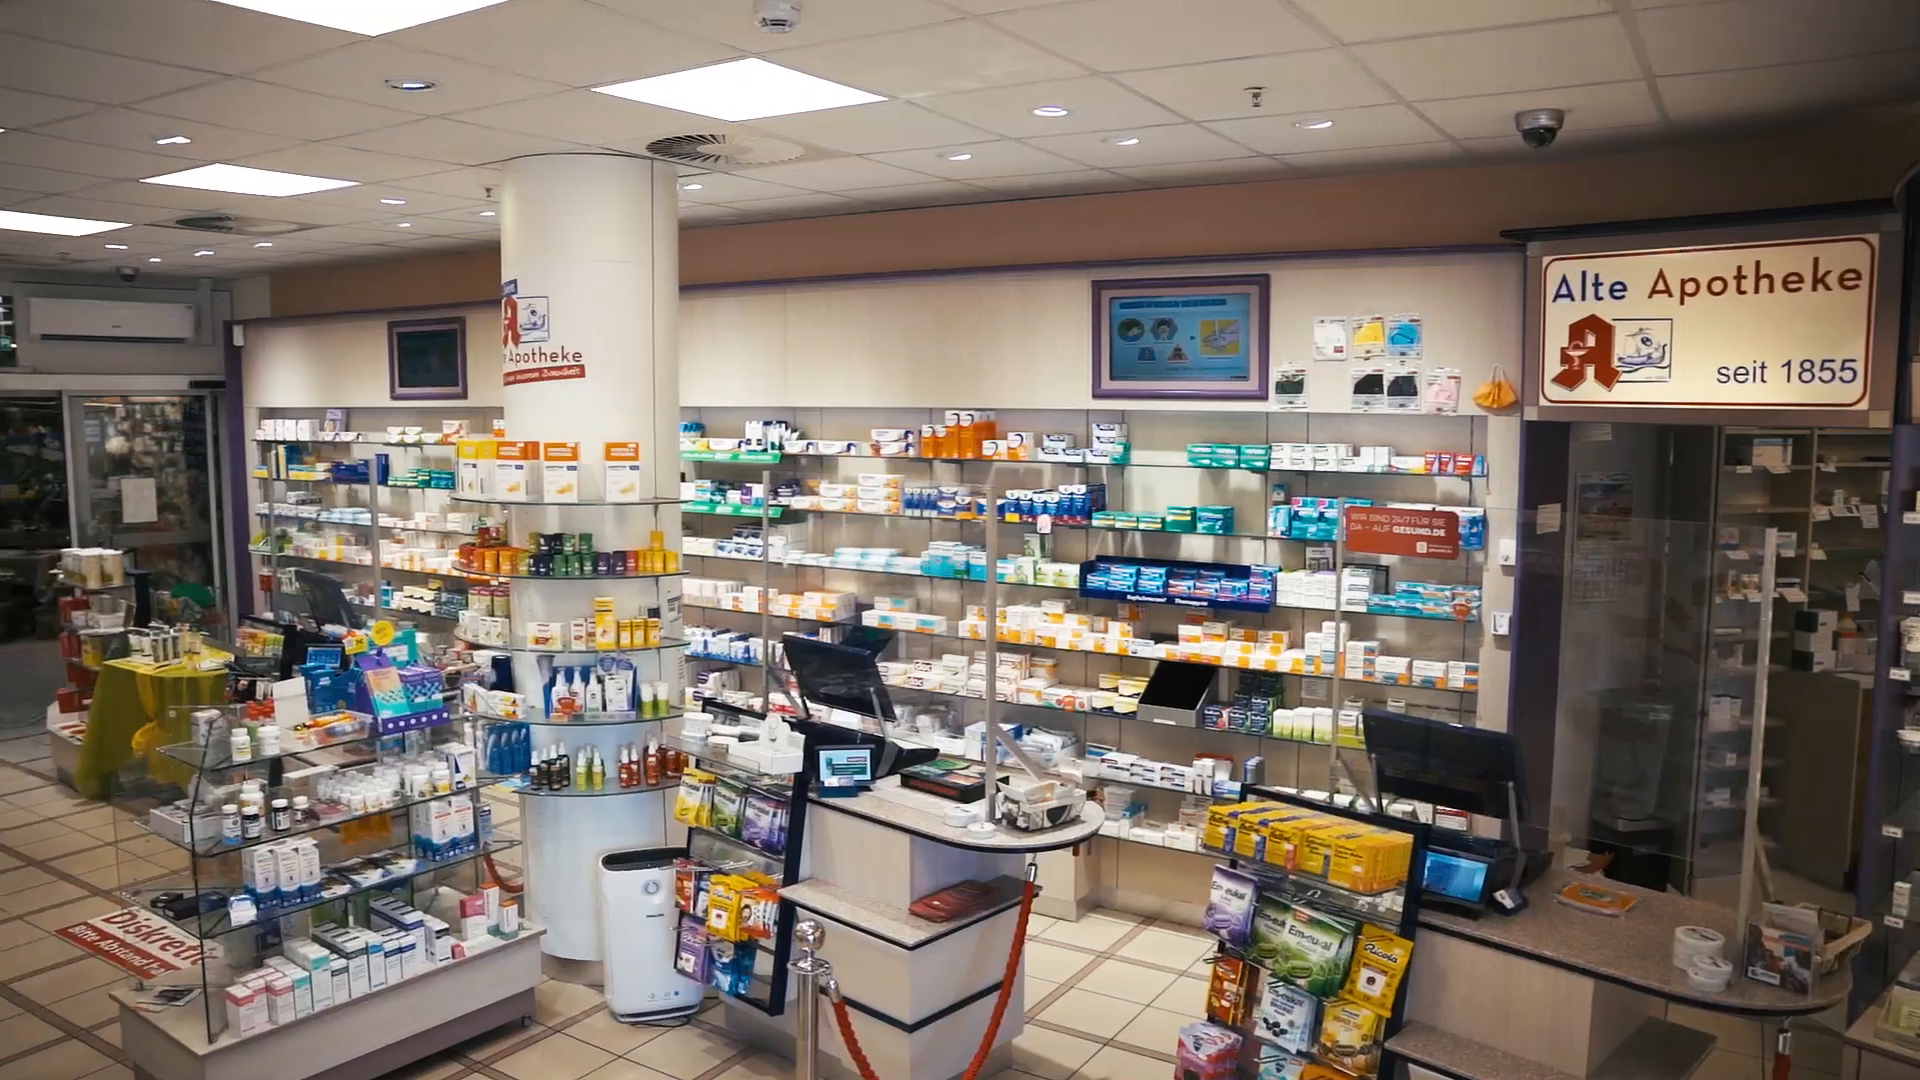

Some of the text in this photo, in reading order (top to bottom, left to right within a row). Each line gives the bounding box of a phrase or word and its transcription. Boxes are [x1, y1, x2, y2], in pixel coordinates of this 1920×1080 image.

[1551, 256, 1864, 305] Alte Apotheke
[508, 345, 582, 367] Apotheke
[1716, 358, 1859, 385] seit 1855
[1349, 523, 1363, 531] DA
[1372, 524, 1391, 533] AUF
[1392, 526, 1446, 537] GESUND.DE
[1351, 514, 1446, 527] WIR SIND 24/7 FÜR SIE
[66, 924, 95, 943] Bitte
[96, 938, 155, 969] Abstand
[1363, 942, 1399, 965] Ricola
